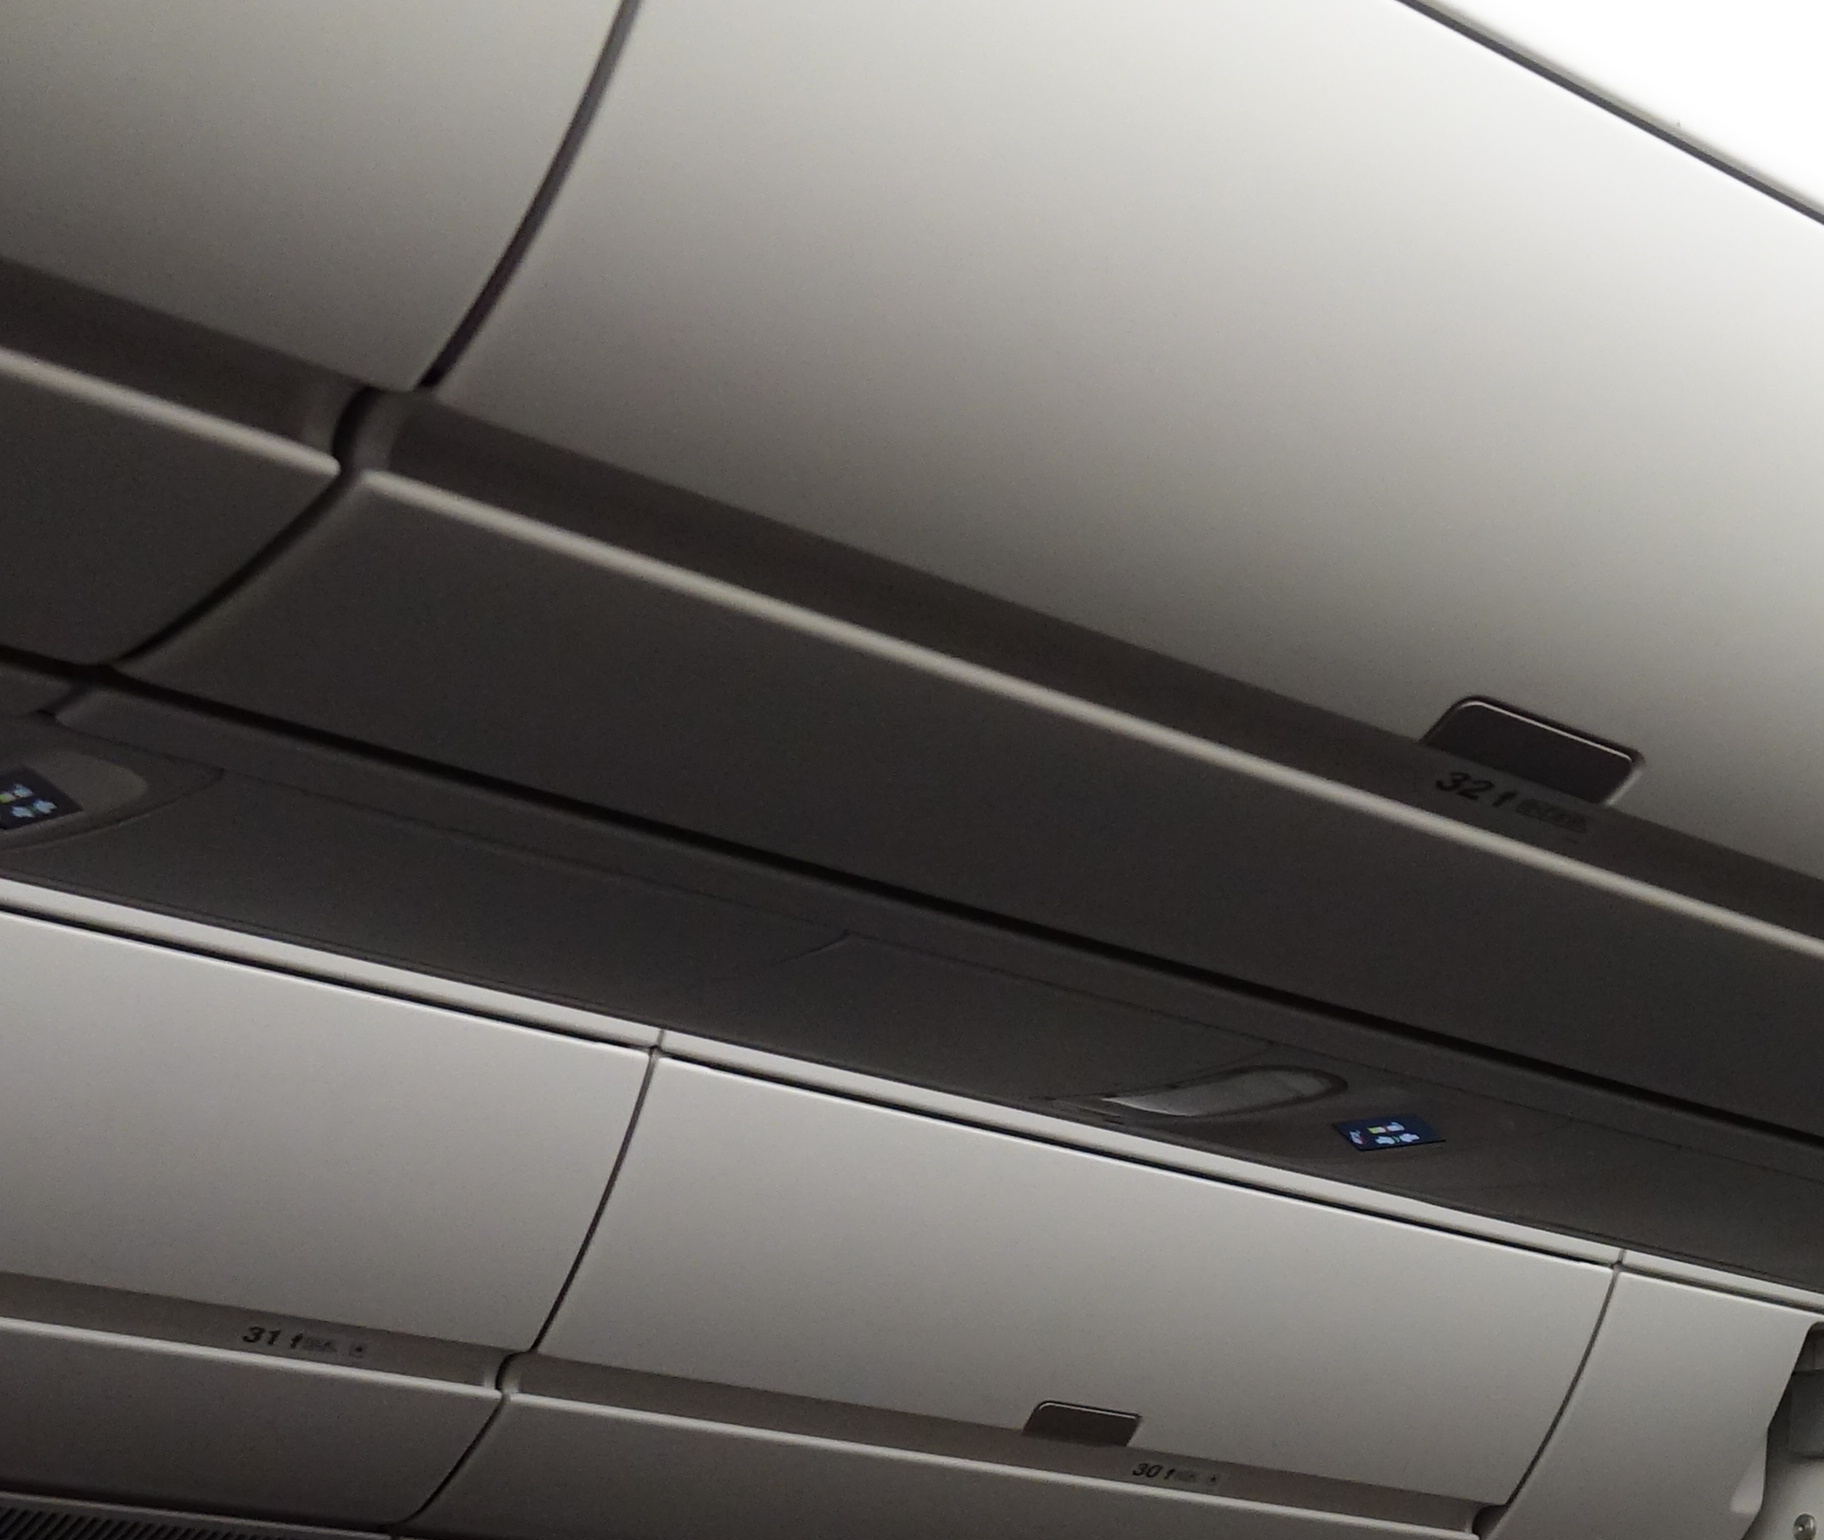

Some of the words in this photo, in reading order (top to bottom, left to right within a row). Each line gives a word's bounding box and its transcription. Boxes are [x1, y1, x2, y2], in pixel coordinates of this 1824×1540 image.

[1435, 772, 1494, 800] 32
[243, 1326, 281, 1346] 31
[1132, 1463, 1161, 1478] 30
